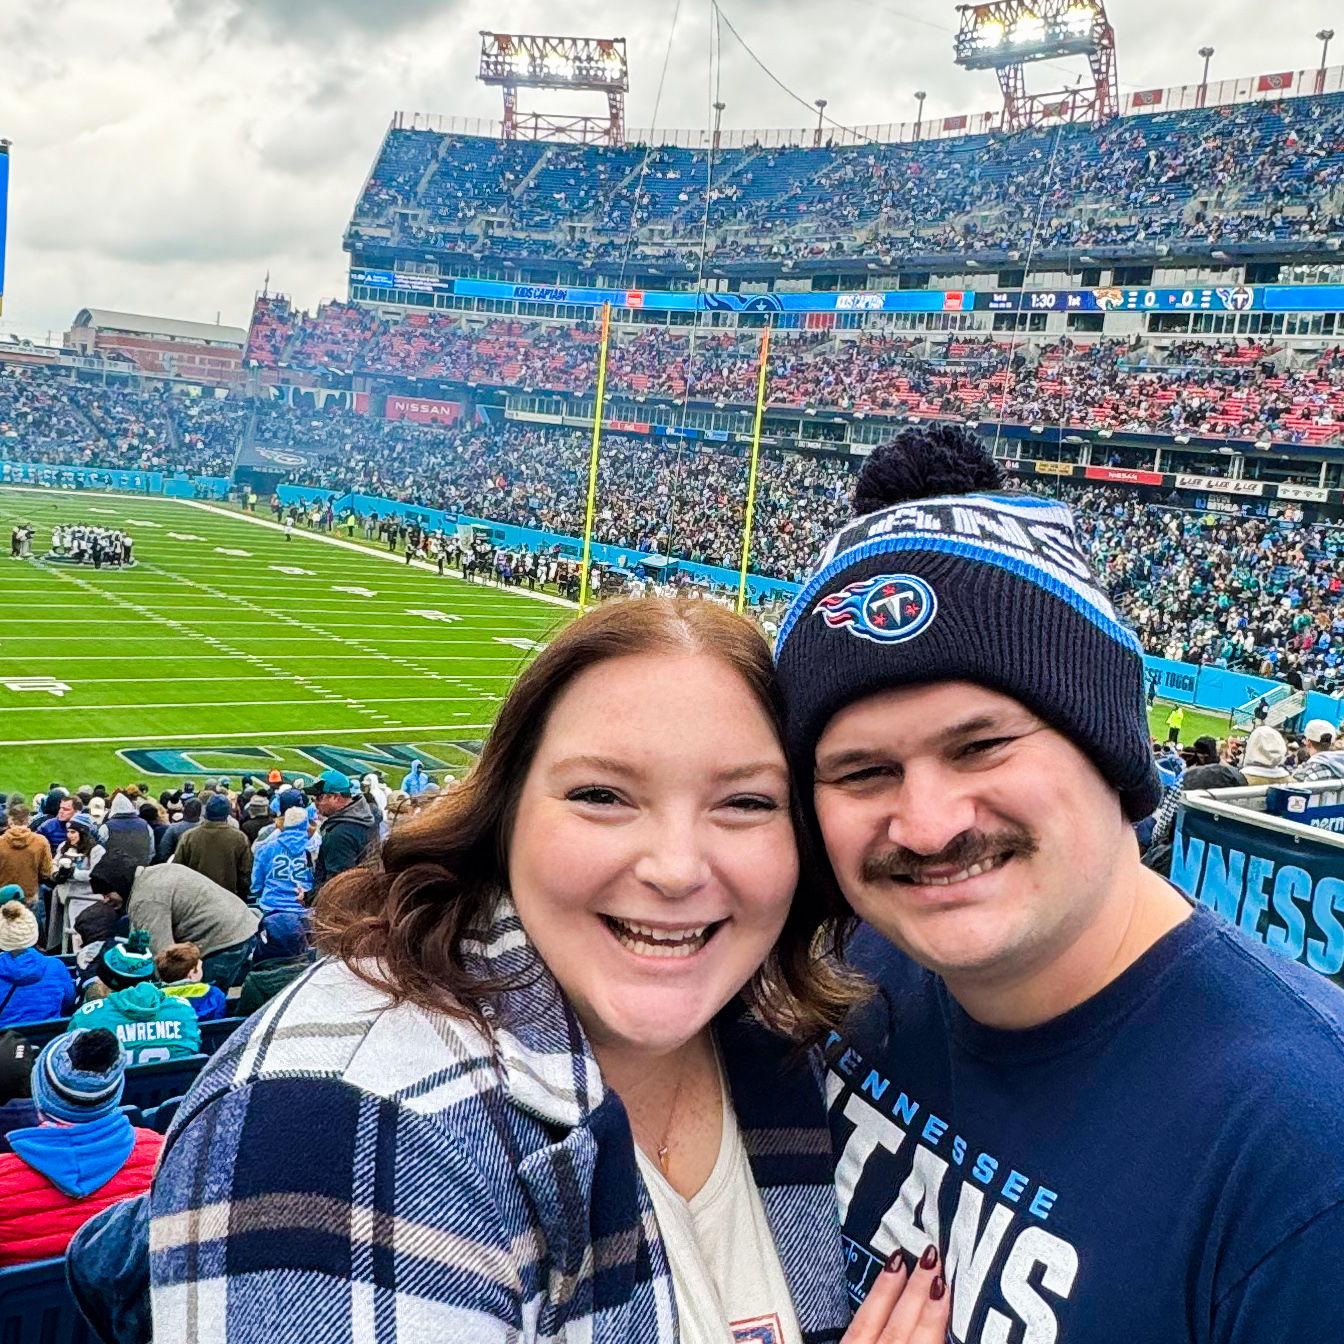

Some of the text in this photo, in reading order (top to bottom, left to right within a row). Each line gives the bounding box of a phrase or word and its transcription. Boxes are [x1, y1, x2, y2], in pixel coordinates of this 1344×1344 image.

[1031, 293, 1056, 308] 1:30
[1144, 291, 1156, 306] 0
[1181, 291, 1194, 306] 0
[394, 401, 451, 416] NISSAN
[1165, 671, 1195, 692] TOUGH
[273, 855, 307, 882] 22
[116, 1020, 182, 1043] AWRENCE
[825, 1029, 1058, 1220] TENNESSEE
